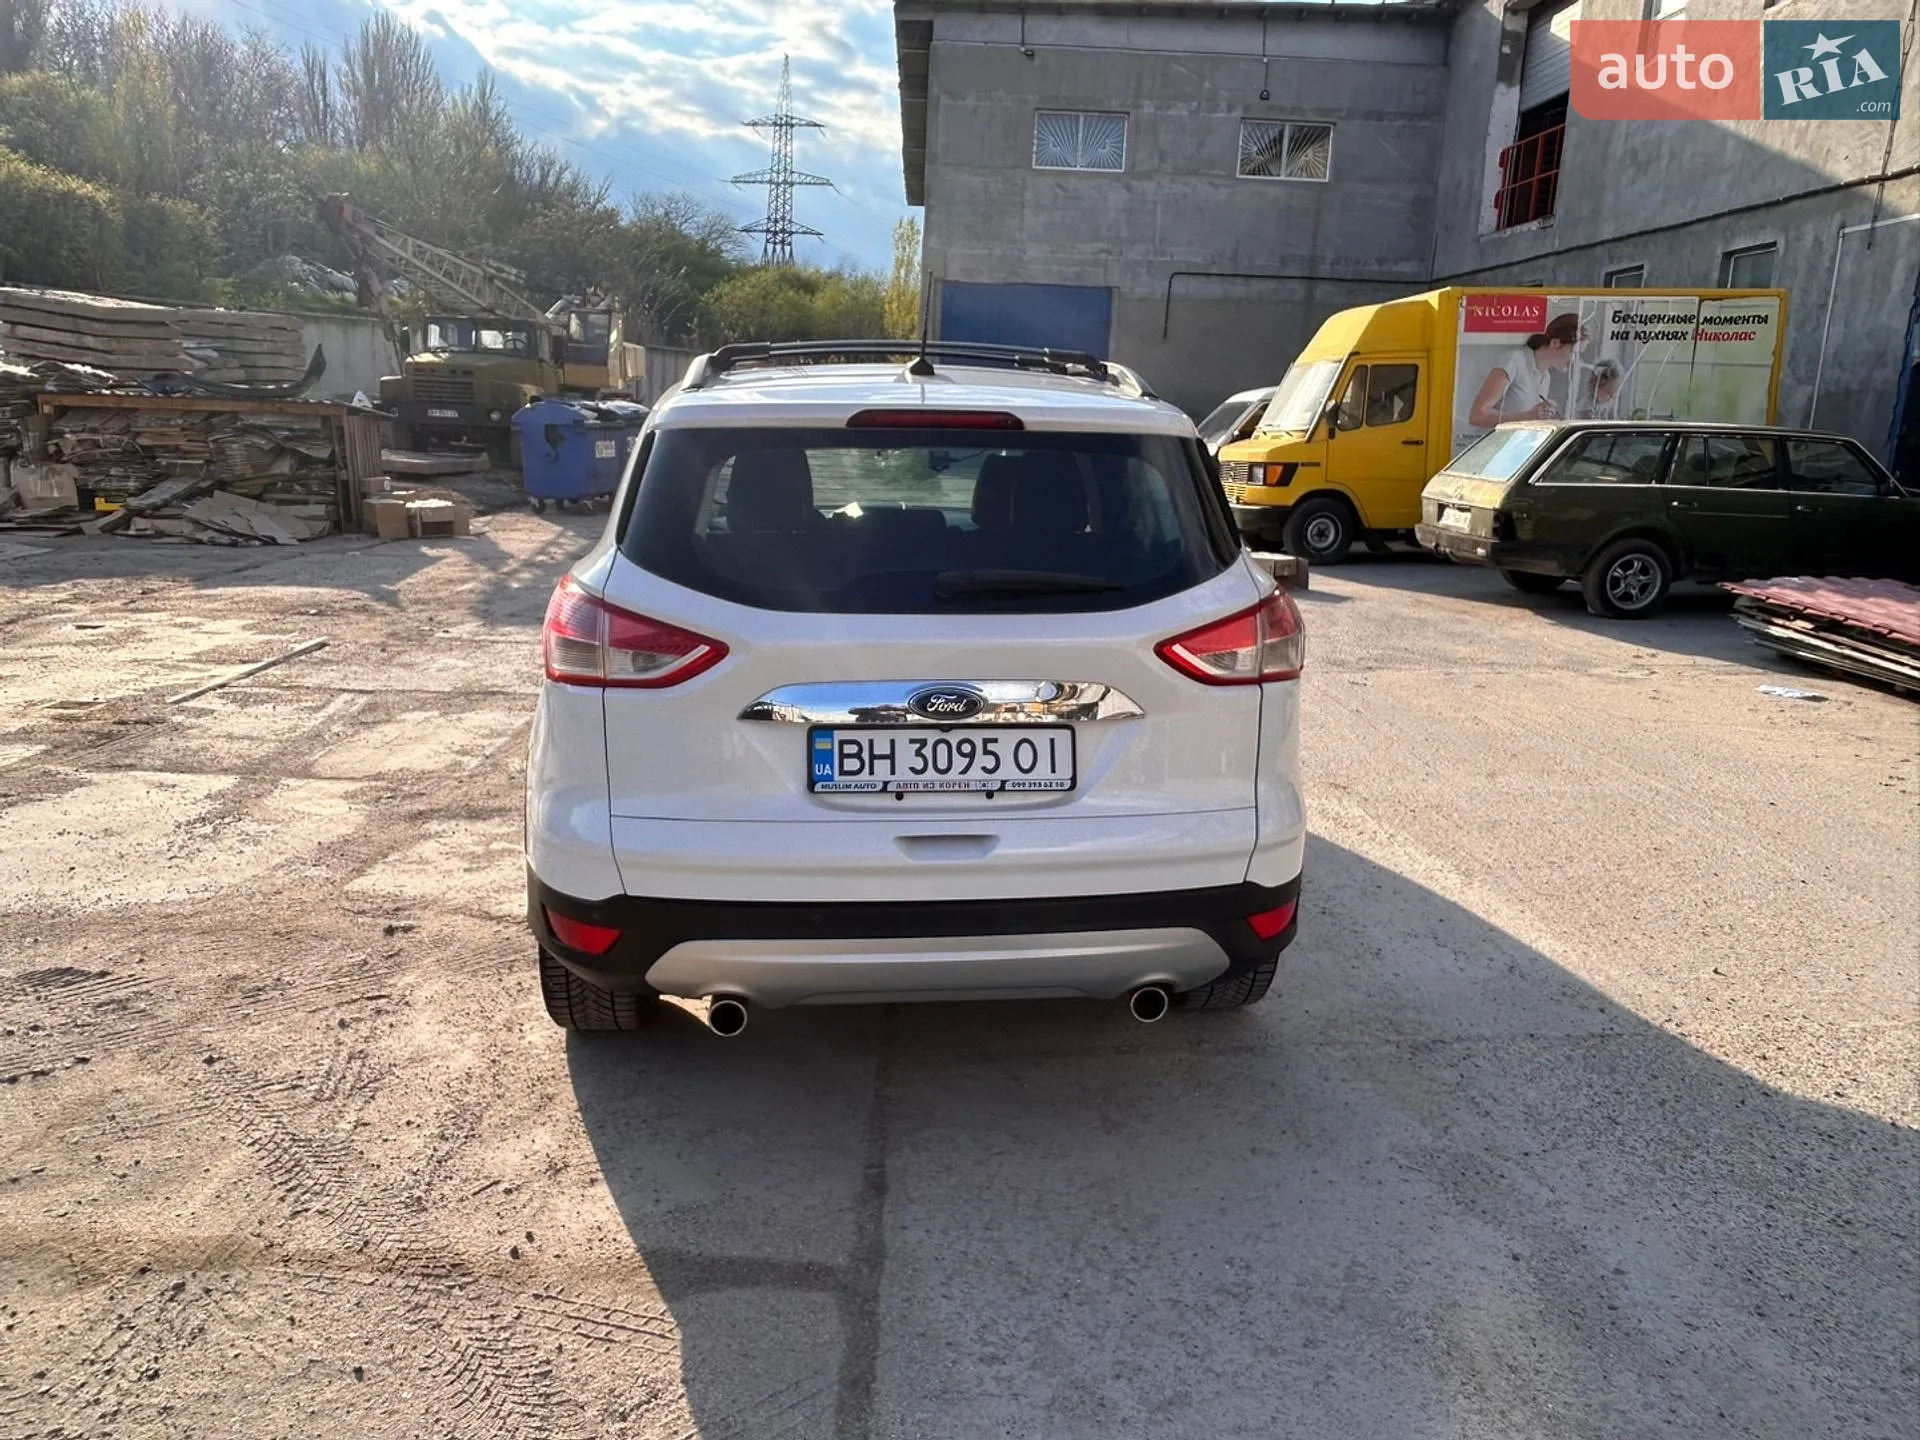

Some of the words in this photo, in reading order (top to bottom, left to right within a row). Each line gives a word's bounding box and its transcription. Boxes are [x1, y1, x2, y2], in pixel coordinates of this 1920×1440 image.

[1473, 304, 1539, 318] NICOLAS
[1611, 310, 1696, 326] Бесценные
[1701, 313, 1769, 326] моменты
[1610, 330, 1630, 341] на
[1634, 330, 1689, 343] кухнях
[1691, 328, 1757, 342] Николас
[926, 694, 967, 712] Ford
[837, 738, 896, 776] BH
[908, 738, 1000, 775] 3095
[815, 764, 832, 776] UA
